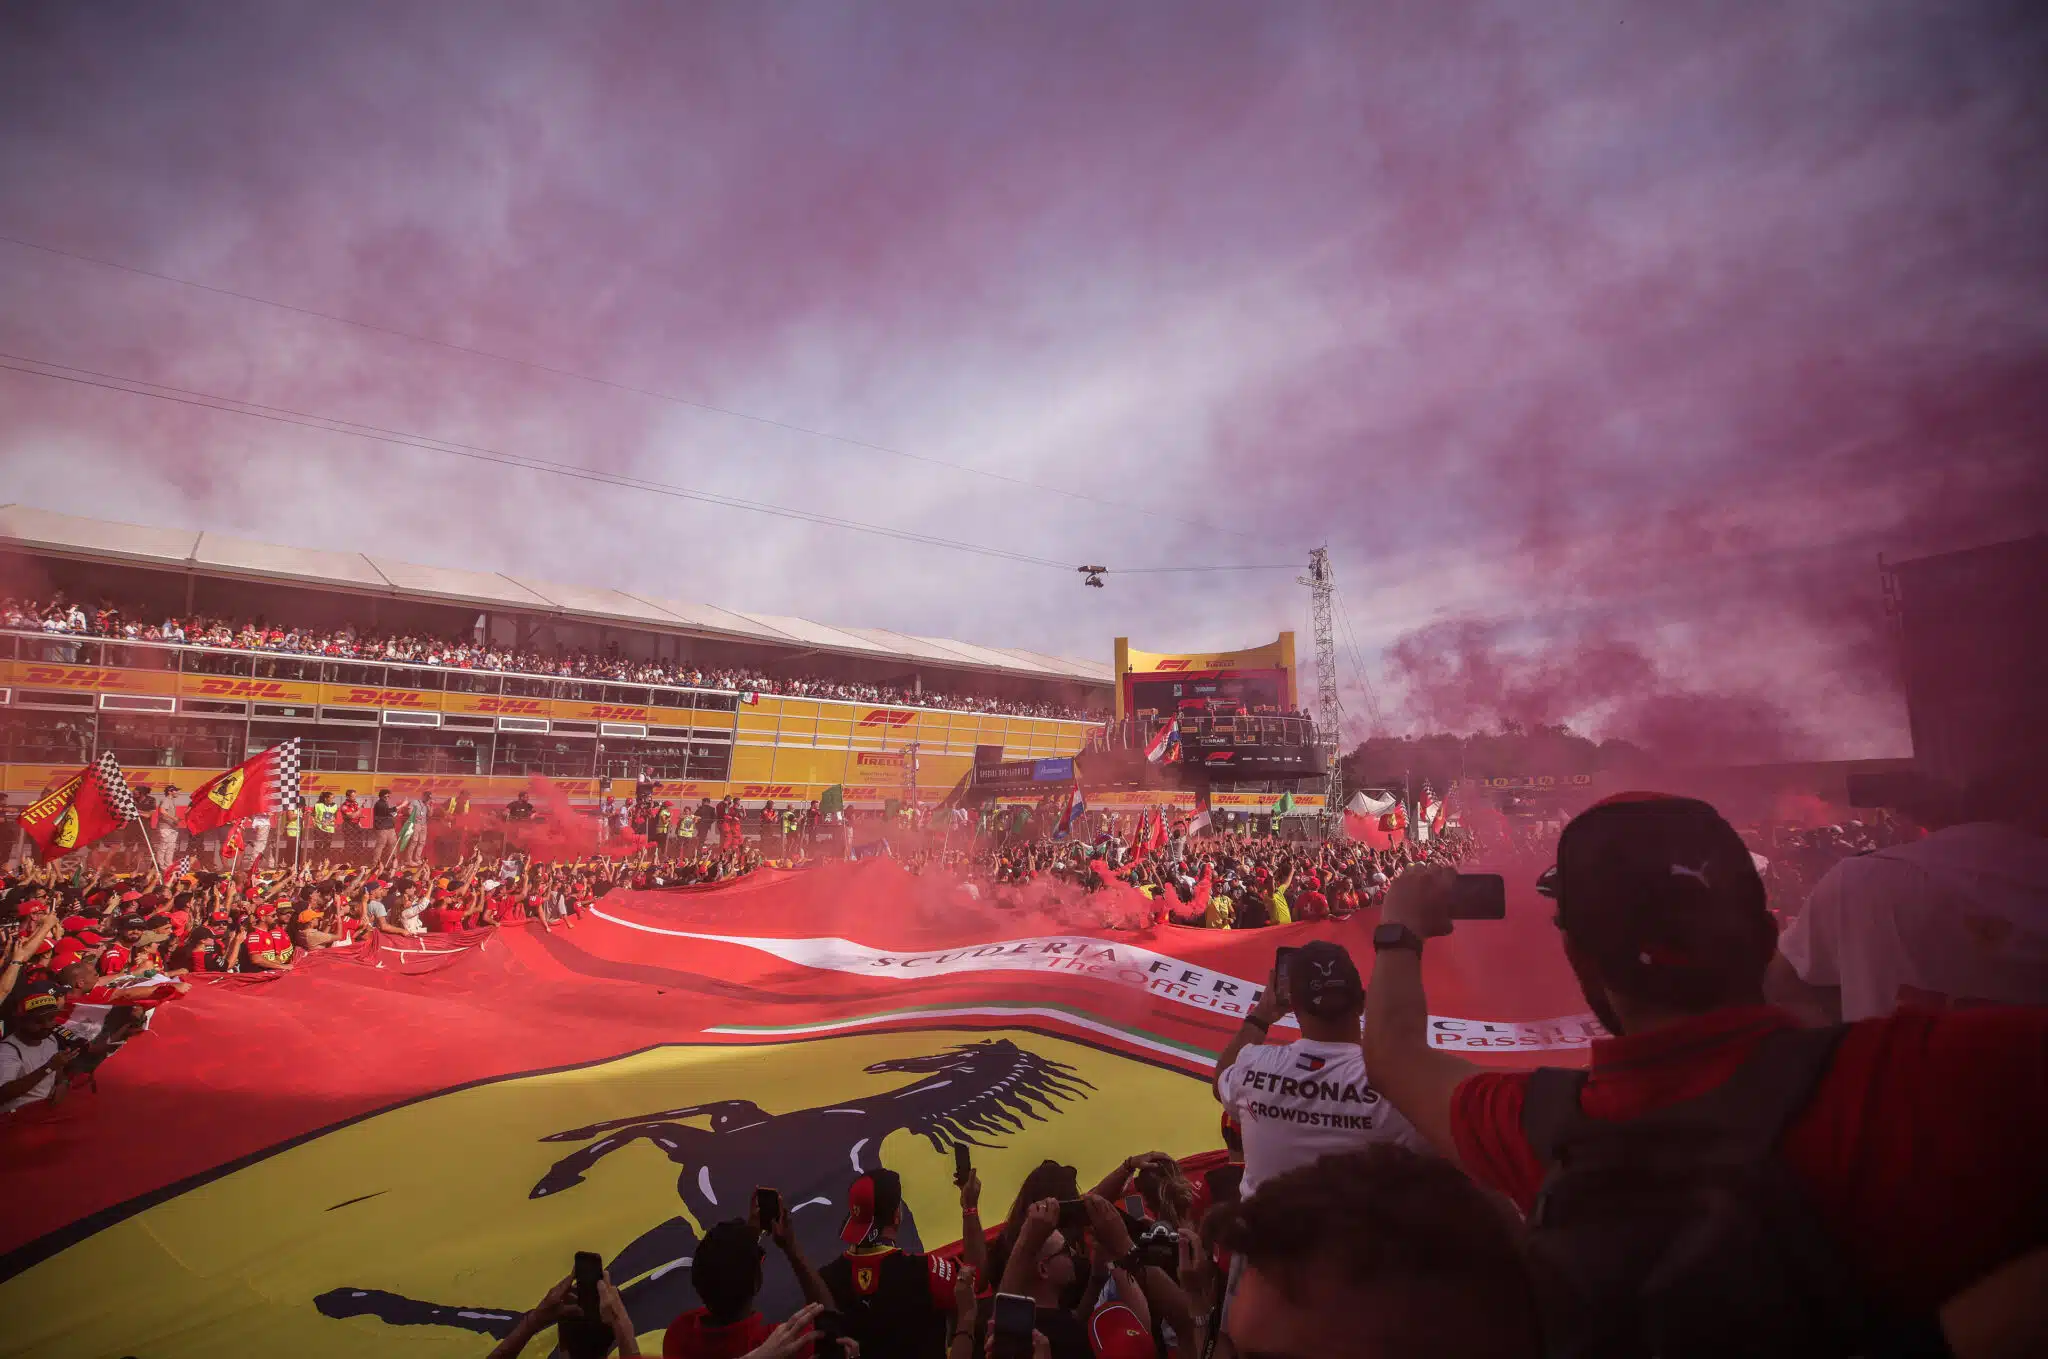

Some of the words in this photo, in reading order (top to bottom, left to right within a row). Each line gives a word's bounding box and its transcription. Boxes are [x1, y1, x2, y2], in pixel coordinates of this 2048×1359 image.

[25, 667, 125, 689] DHL
[199, 678, 285, 699] DHL
[347, 688, 424, 707] DHL
[476, 697, 544, 714] DHL
[590, 706, 648, 721] DHL
[859, 709, 917, 728] F1
[857, 752, 905, 767] PIRELLI
[390, 778, 464, 797] DHL
[743, 785, 793, 798] DHL
[1217, 796, 1241, 804] DHL
[1295, 796, 1315, 805] DHL
[871, 941, 1117, 968] SCUDERIA
[1047, 956, 1105, 974] The
[1243, 1069, 1379, 1105] PETRONAS
[1249, 1101, 1373, 1130] CROWDSTRIKE
